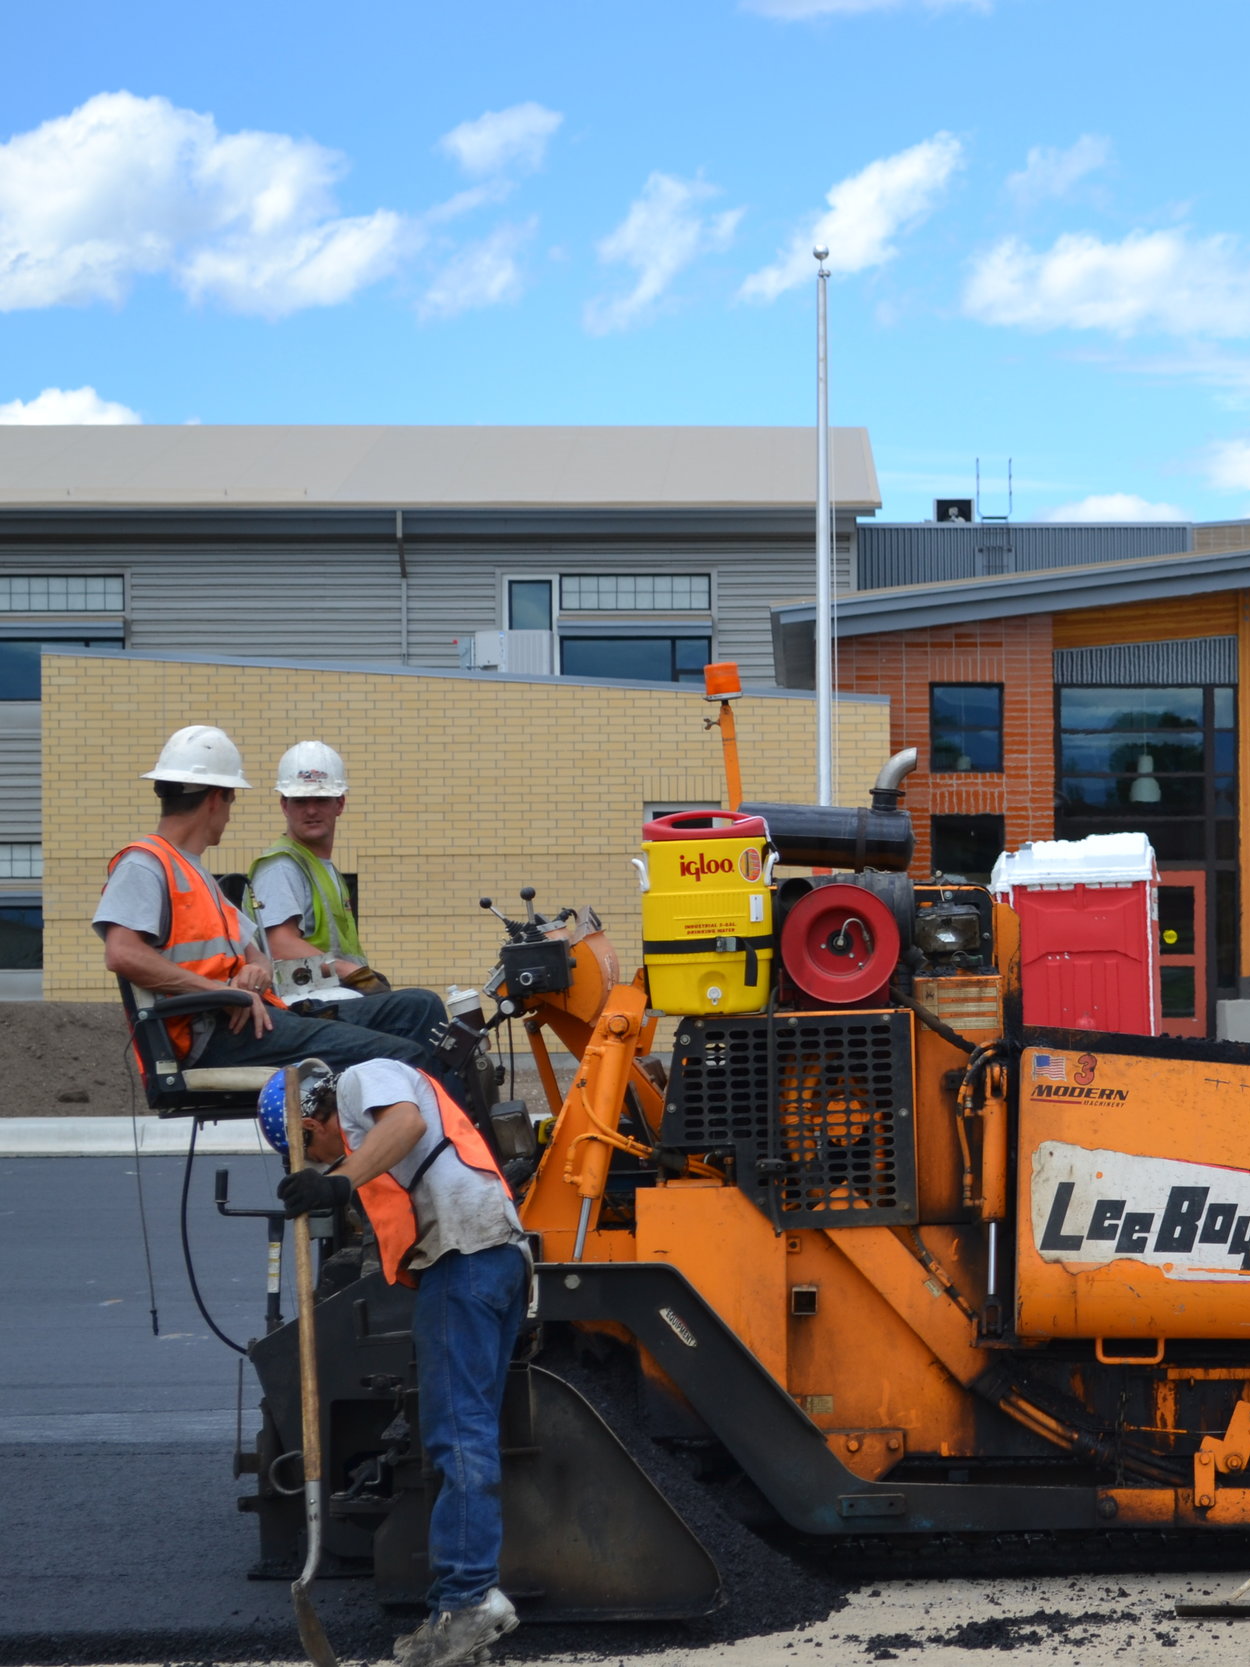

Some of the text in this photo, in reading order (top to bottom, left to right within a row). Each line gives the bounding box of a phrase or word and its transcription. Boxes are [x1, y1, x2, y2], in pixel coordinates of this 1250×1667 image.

[679, 853, 733, 882] igloo
[1031, 1084, 1129, 1101] MODERN
[1083, 1100, 1125, 1108] MACHINERY
[665, 1309, 695, 1345] EQUIPMENT
